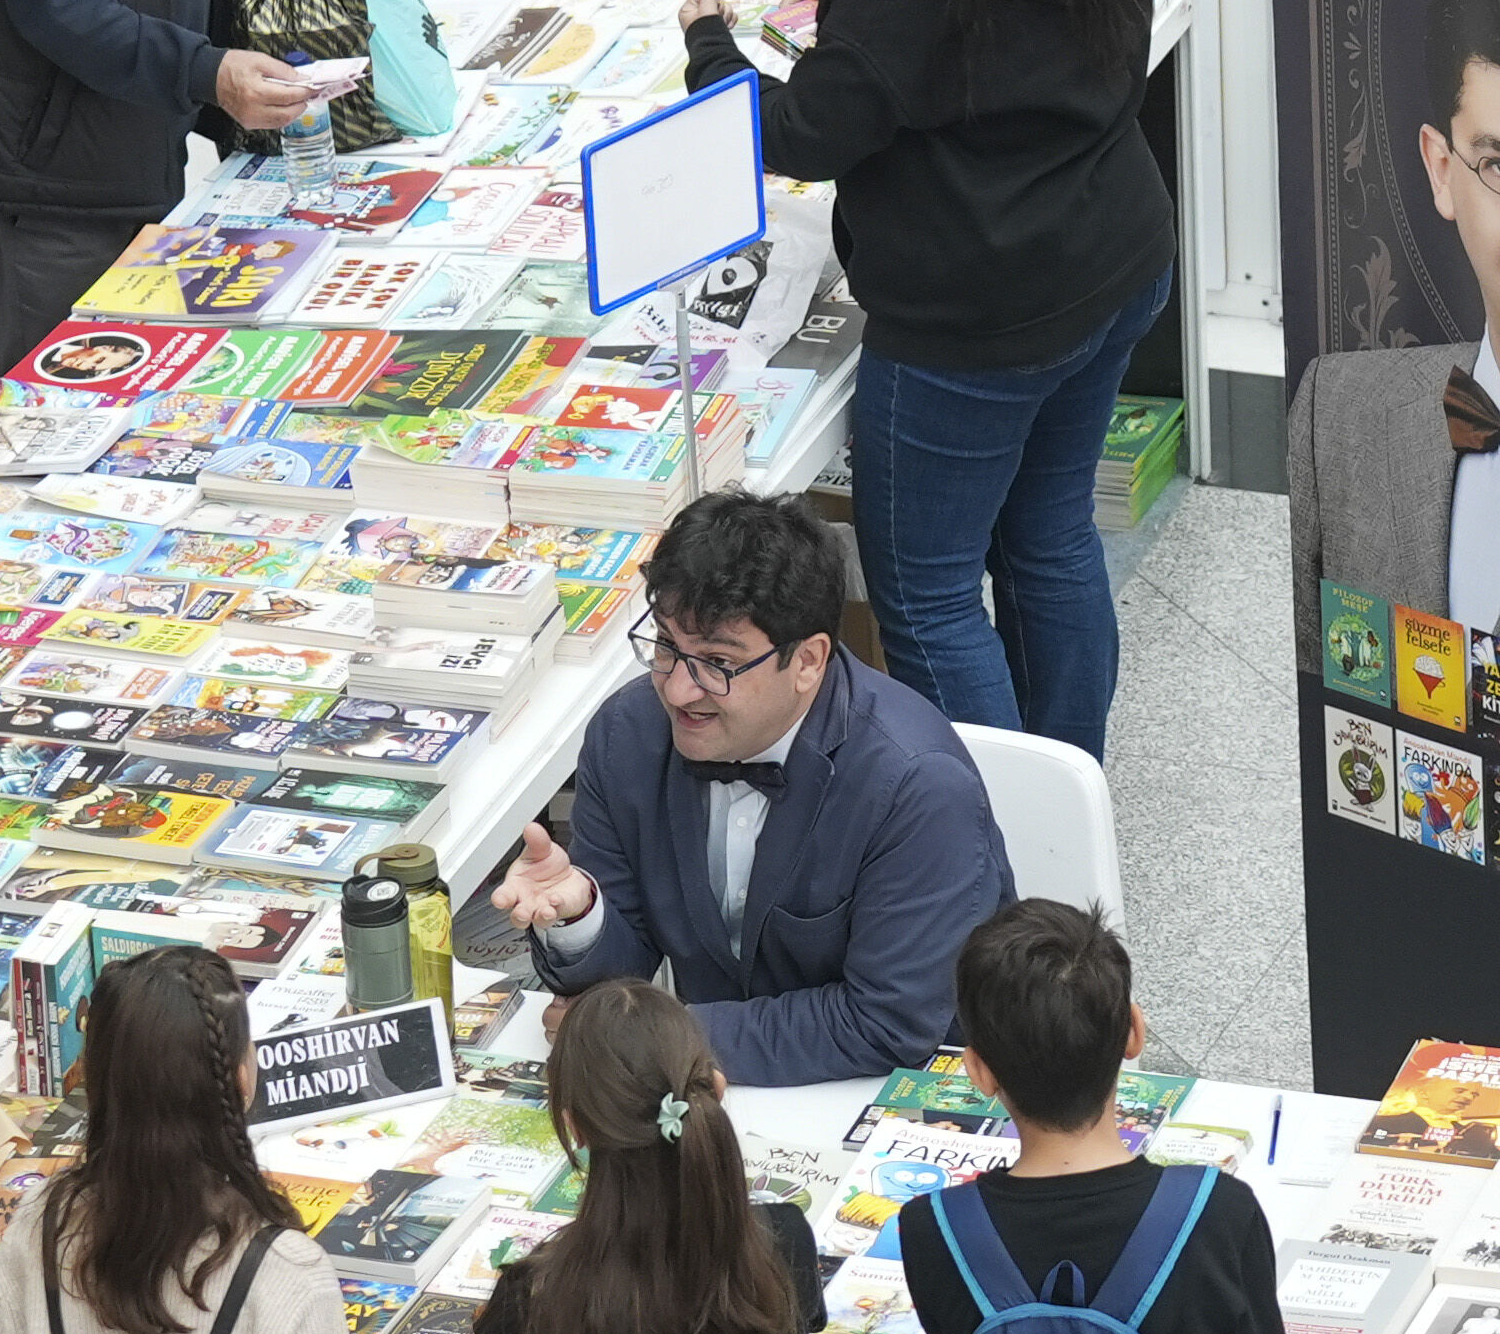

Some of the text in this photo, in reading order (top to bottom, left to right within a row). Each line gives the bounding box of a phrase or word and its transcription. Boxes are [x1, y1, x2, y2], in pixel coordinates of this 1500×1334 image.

[1404, 618, 1451, 643] süzme
[1406, 631, 1451, 657] felsefe
[1404, 746, 1473, 777] FARKINDA
[257, 1017, 401, 1069] OOSHİRVAN
[265, 1061, 371, 1108] MİANDJİ
[885, 1138, 1019, 1173] FARKIN
[1307, 1249, 1391, 1265] Turgut Özakman
